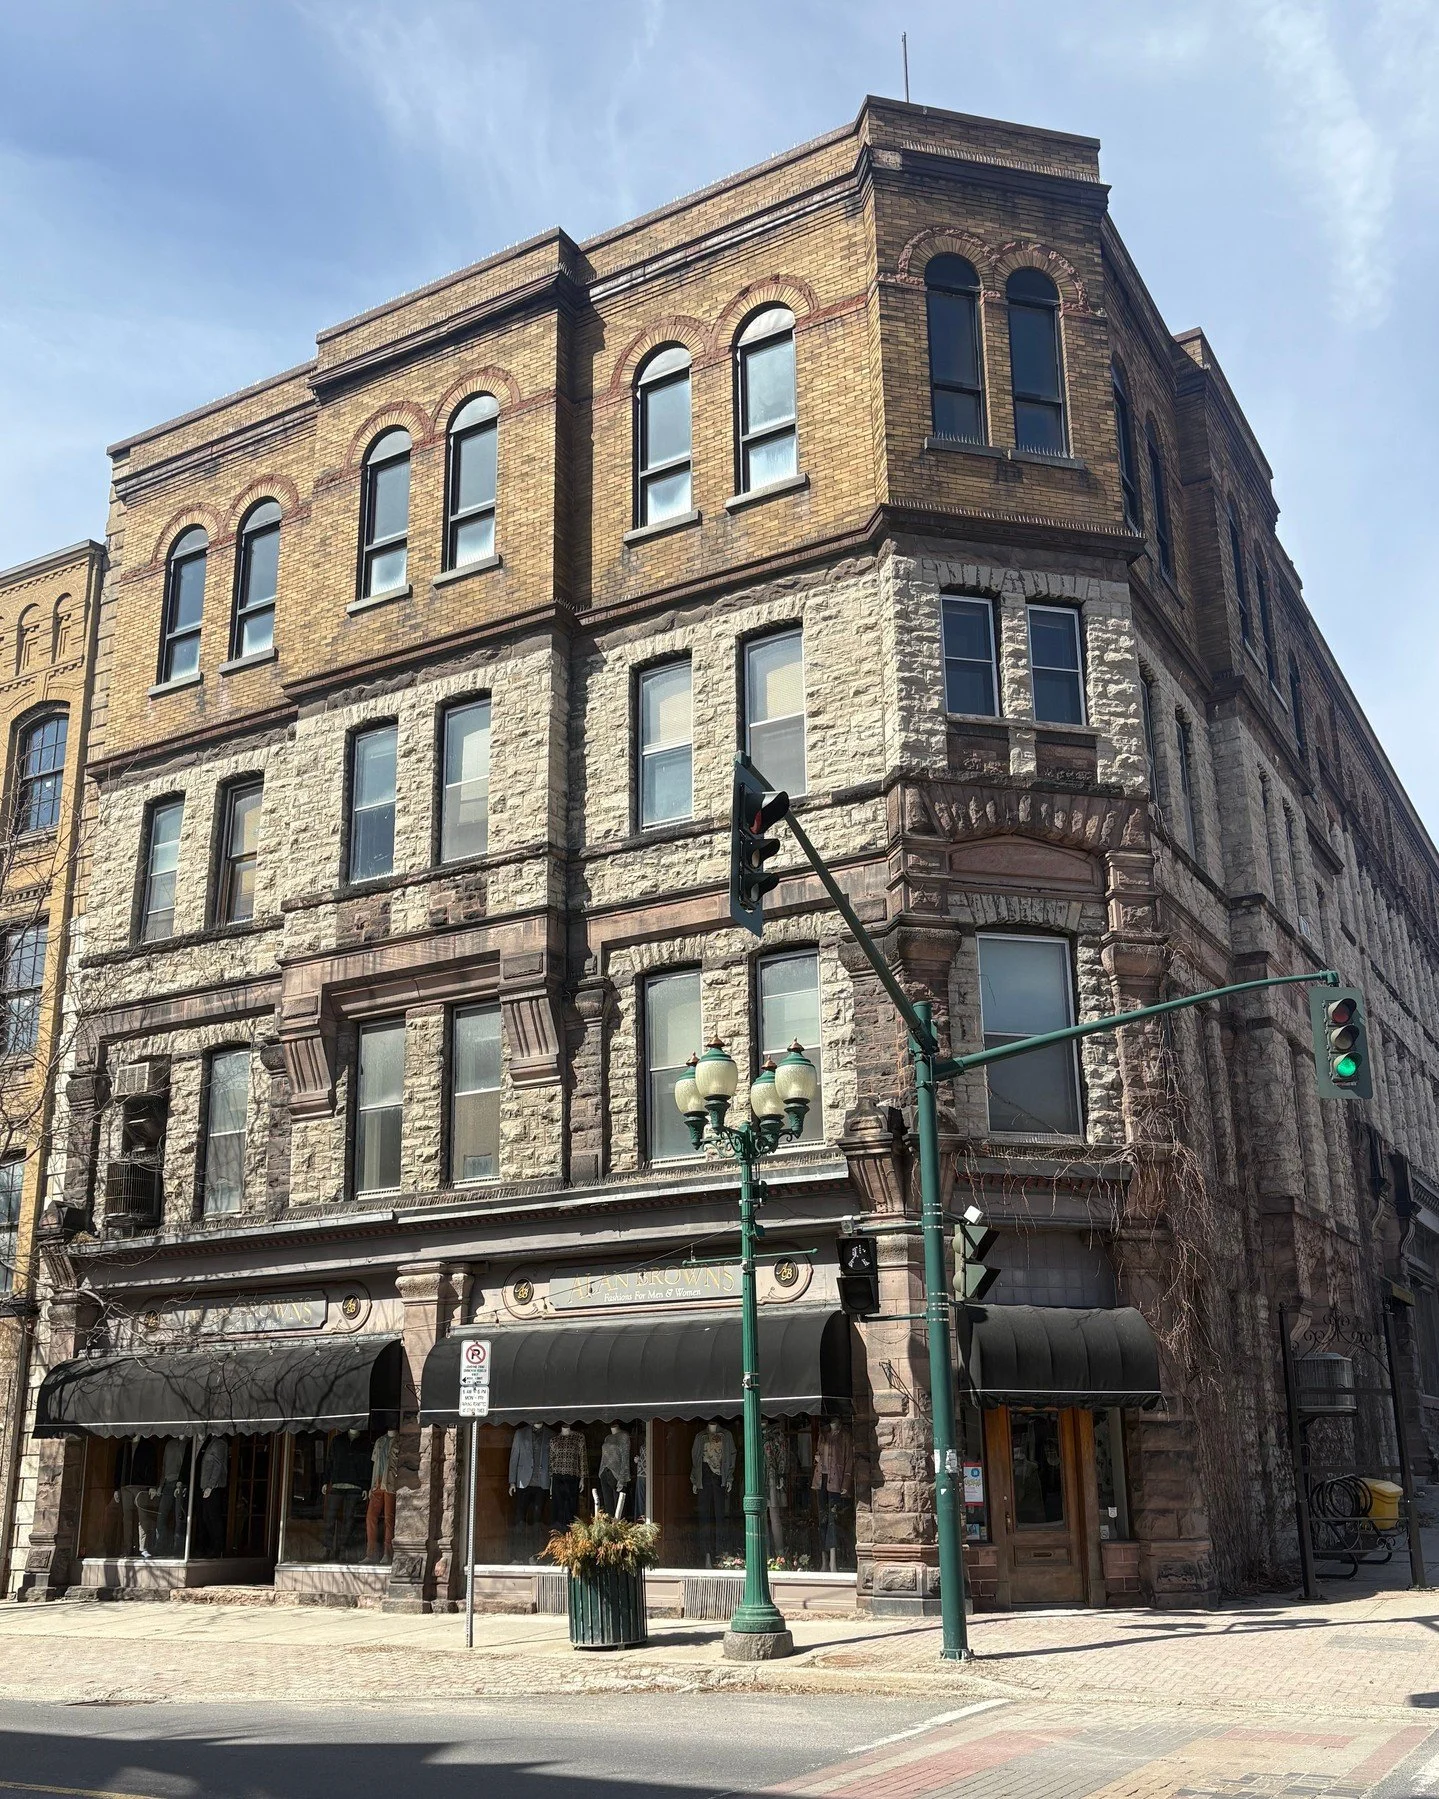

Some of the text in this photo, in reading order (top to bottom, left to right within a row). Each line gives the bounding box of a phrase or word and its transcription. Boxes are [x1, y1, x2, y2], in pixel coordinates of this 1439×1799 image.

[568, 1261, 735, 1304] ALAN BROWNS
[604, 1288, 702, 1303] Fashions For Men & Women
